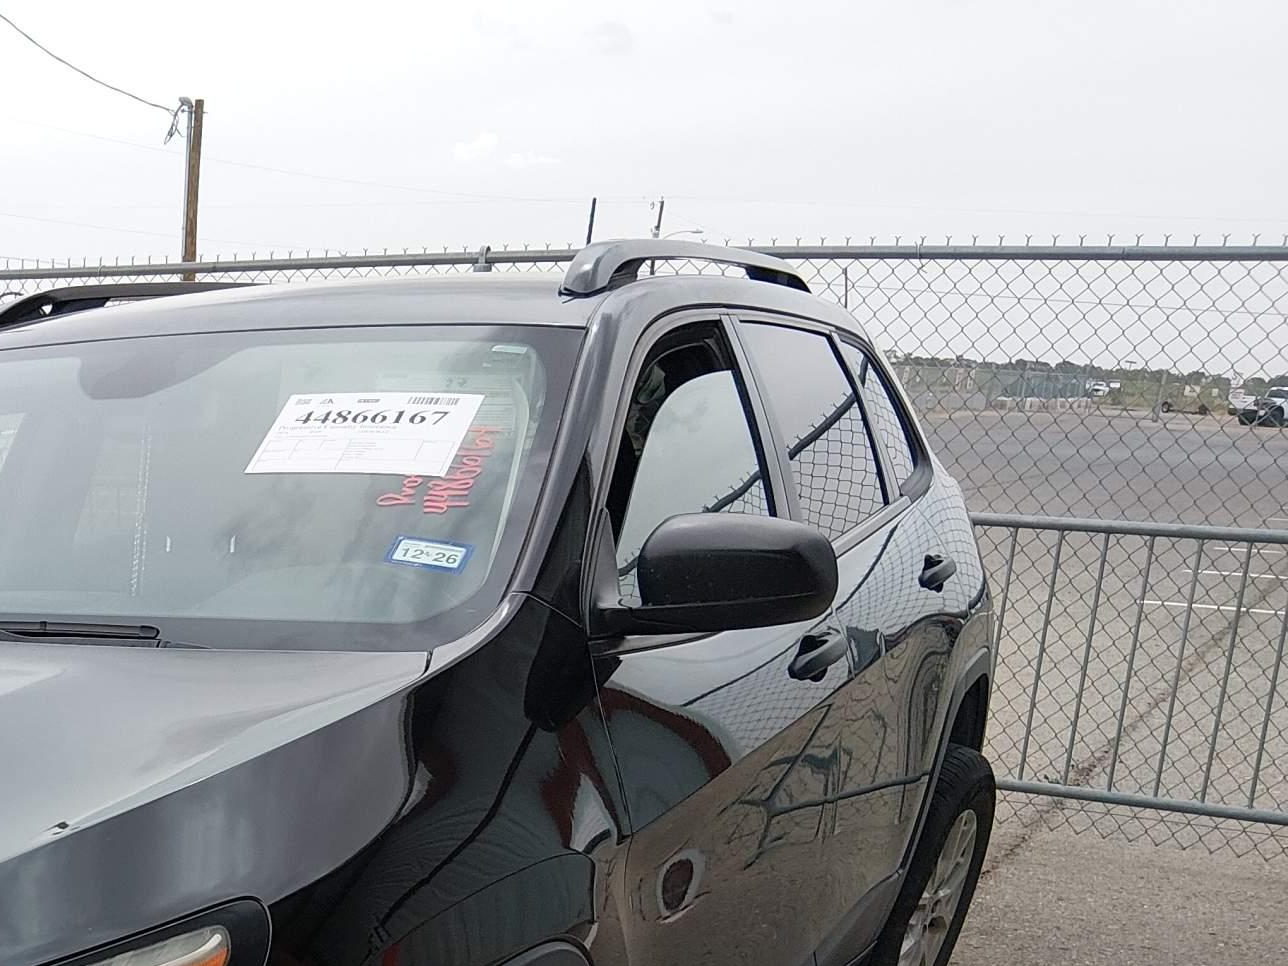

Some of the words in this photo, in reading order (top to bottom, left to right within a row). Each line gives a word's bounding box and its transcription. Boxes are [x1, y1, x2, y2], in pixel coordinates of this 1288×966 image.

[295, 409, 450, 426] 44866167
[376, 474, 423, 507] Pro
[402, 547, 424, 560] 12
[432, 552, 459, 565] 26
